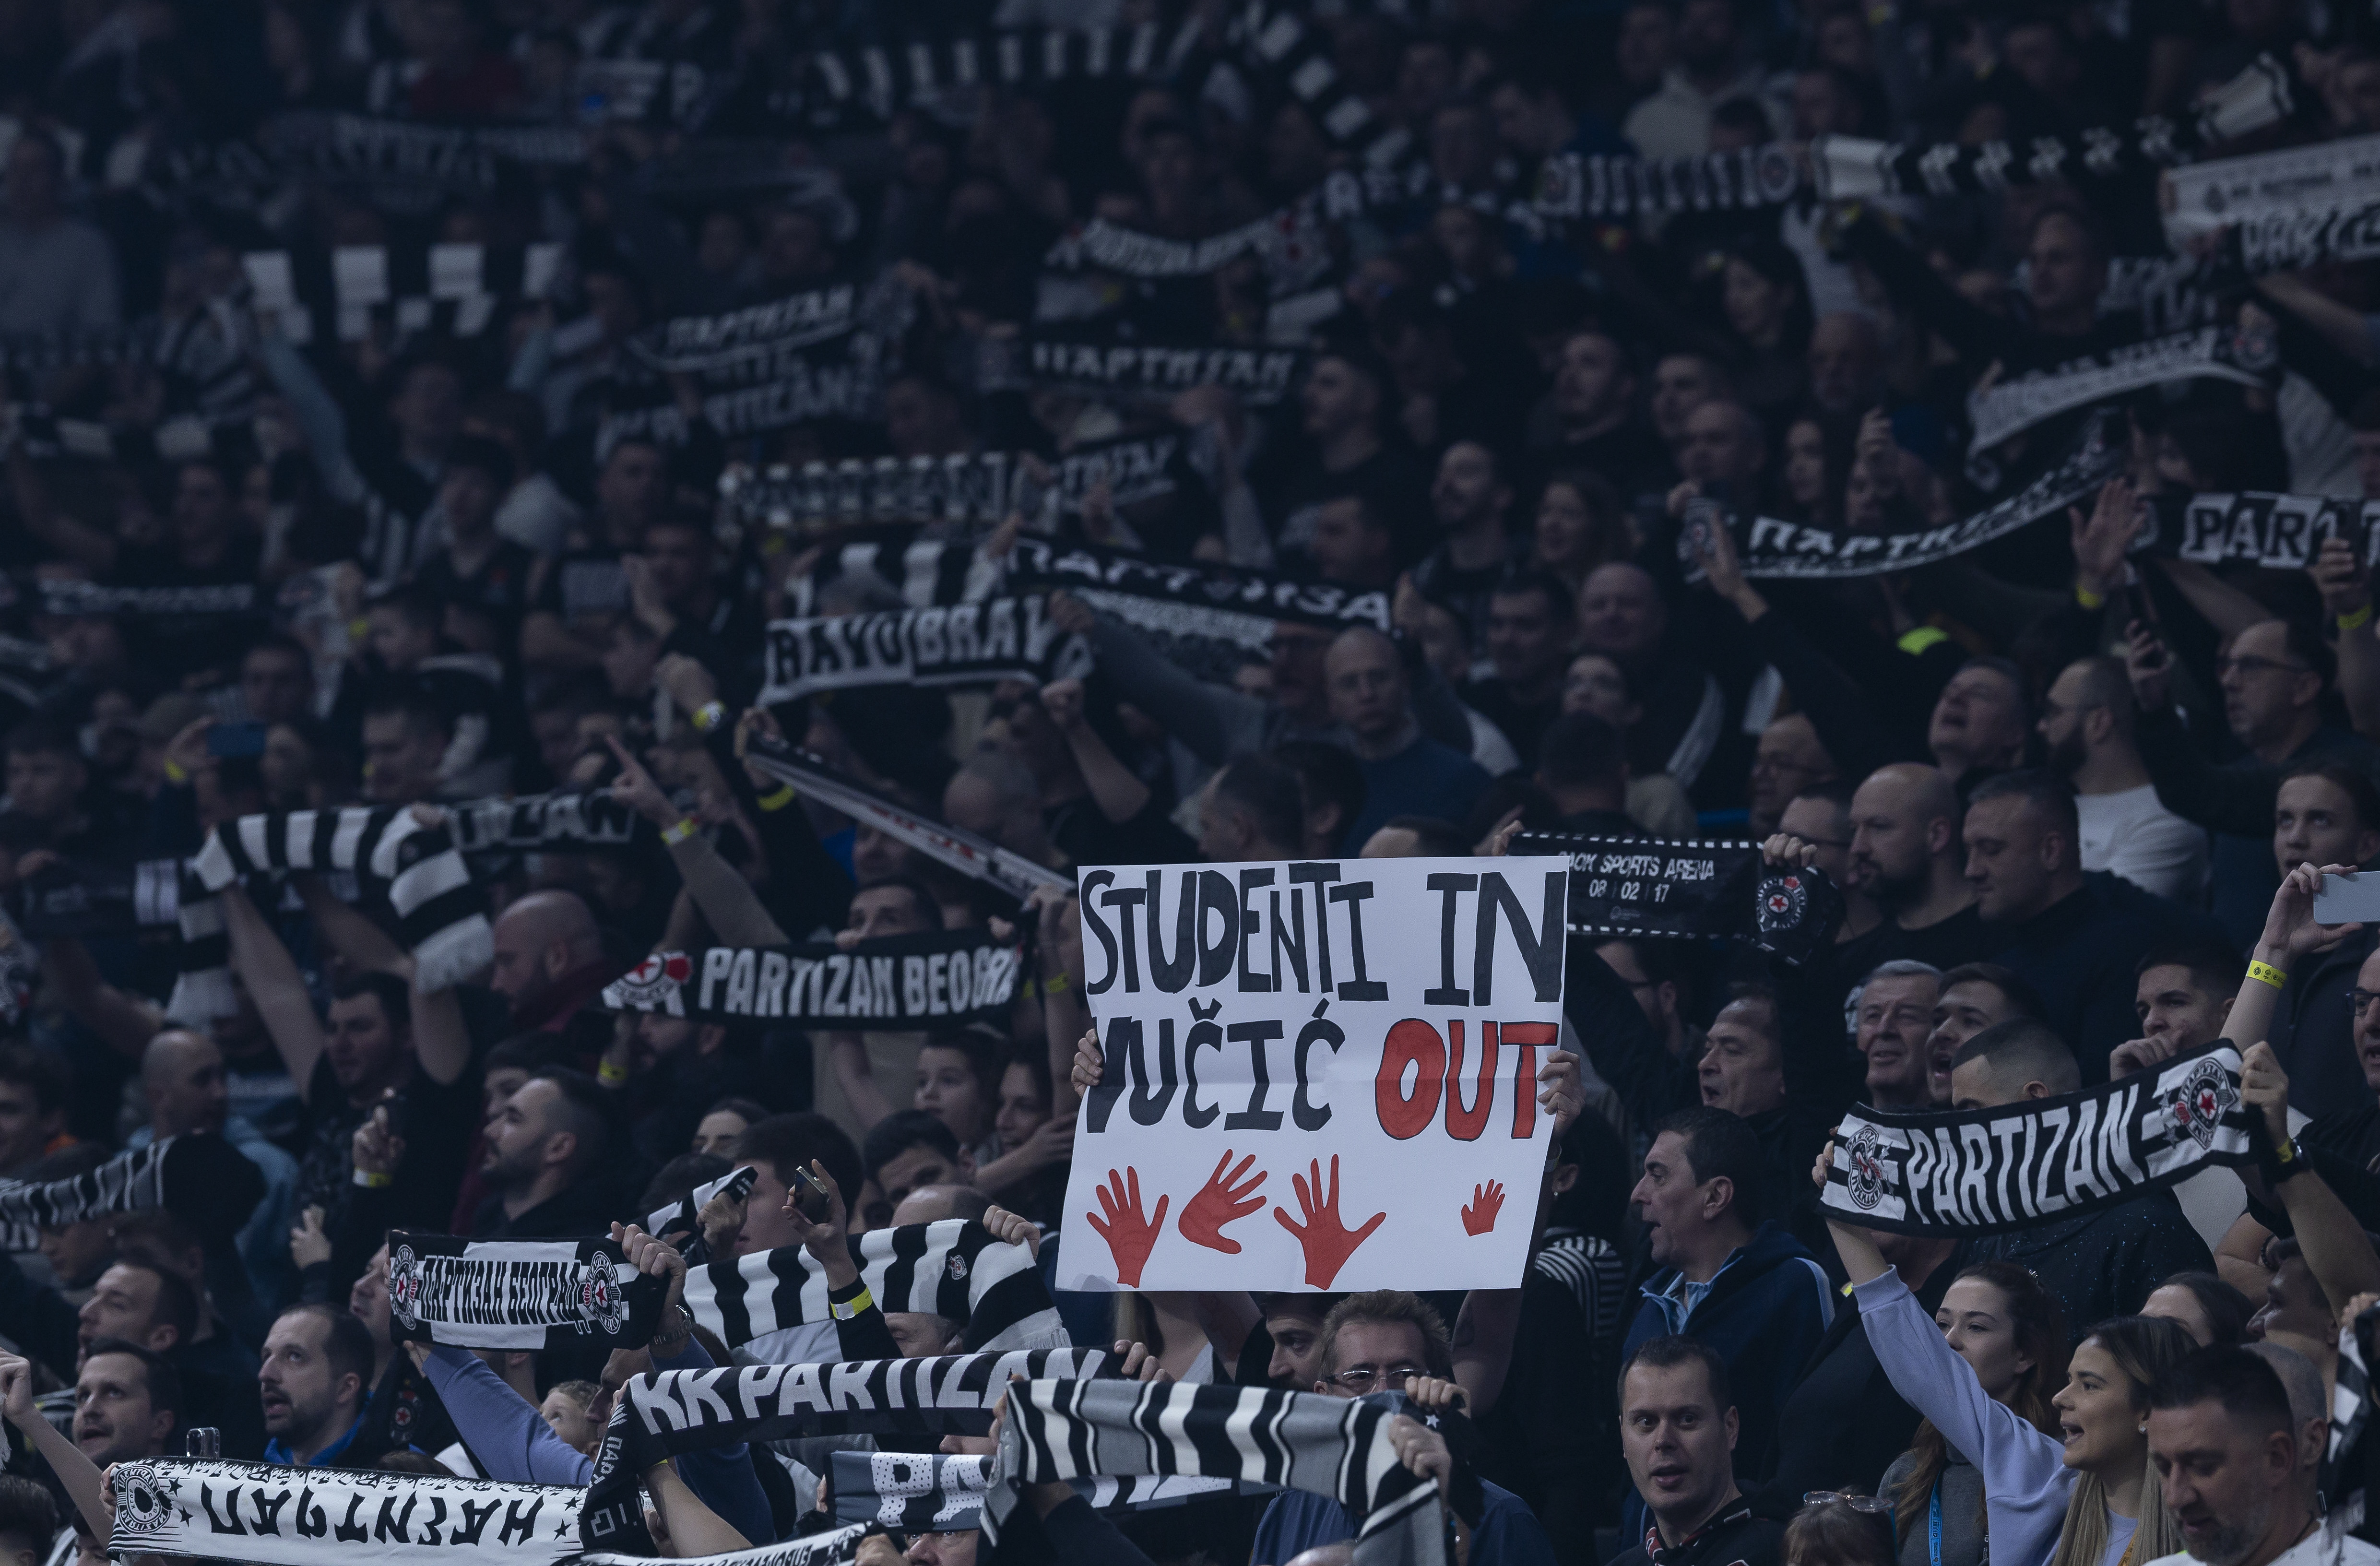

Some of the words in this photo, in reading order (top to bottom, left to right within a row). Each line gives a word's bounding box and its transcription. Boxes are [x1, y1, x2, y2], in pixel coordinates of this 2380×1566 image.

[1599, 854, 1660, 877] SPORTS
[1664, 858, 1715, 882] ARENA
[1621, 881, 1640, 901] 02
[1654, 883, 1670, 902] 17
[1080, 862, 1389, 1002] STUDENTI
[1424, 871, 1567, 1007] IN
[699, 947, 897, 1018] PARTIZAN
[1086, 997, 1346, 1134] VUČIĆ
[1375, 1018, 1560, 1142] OUT
[1906, 1083, 2145, 1225] PARTIZAN
[419, 1255, 508, 1325] ПАРТИЗАН
[506, 1260, 592, 1335] БЕОГРАД
[629, 1366, 734, 1436] KK
[738, 1348, 1106, 1419] PARTIZAN
